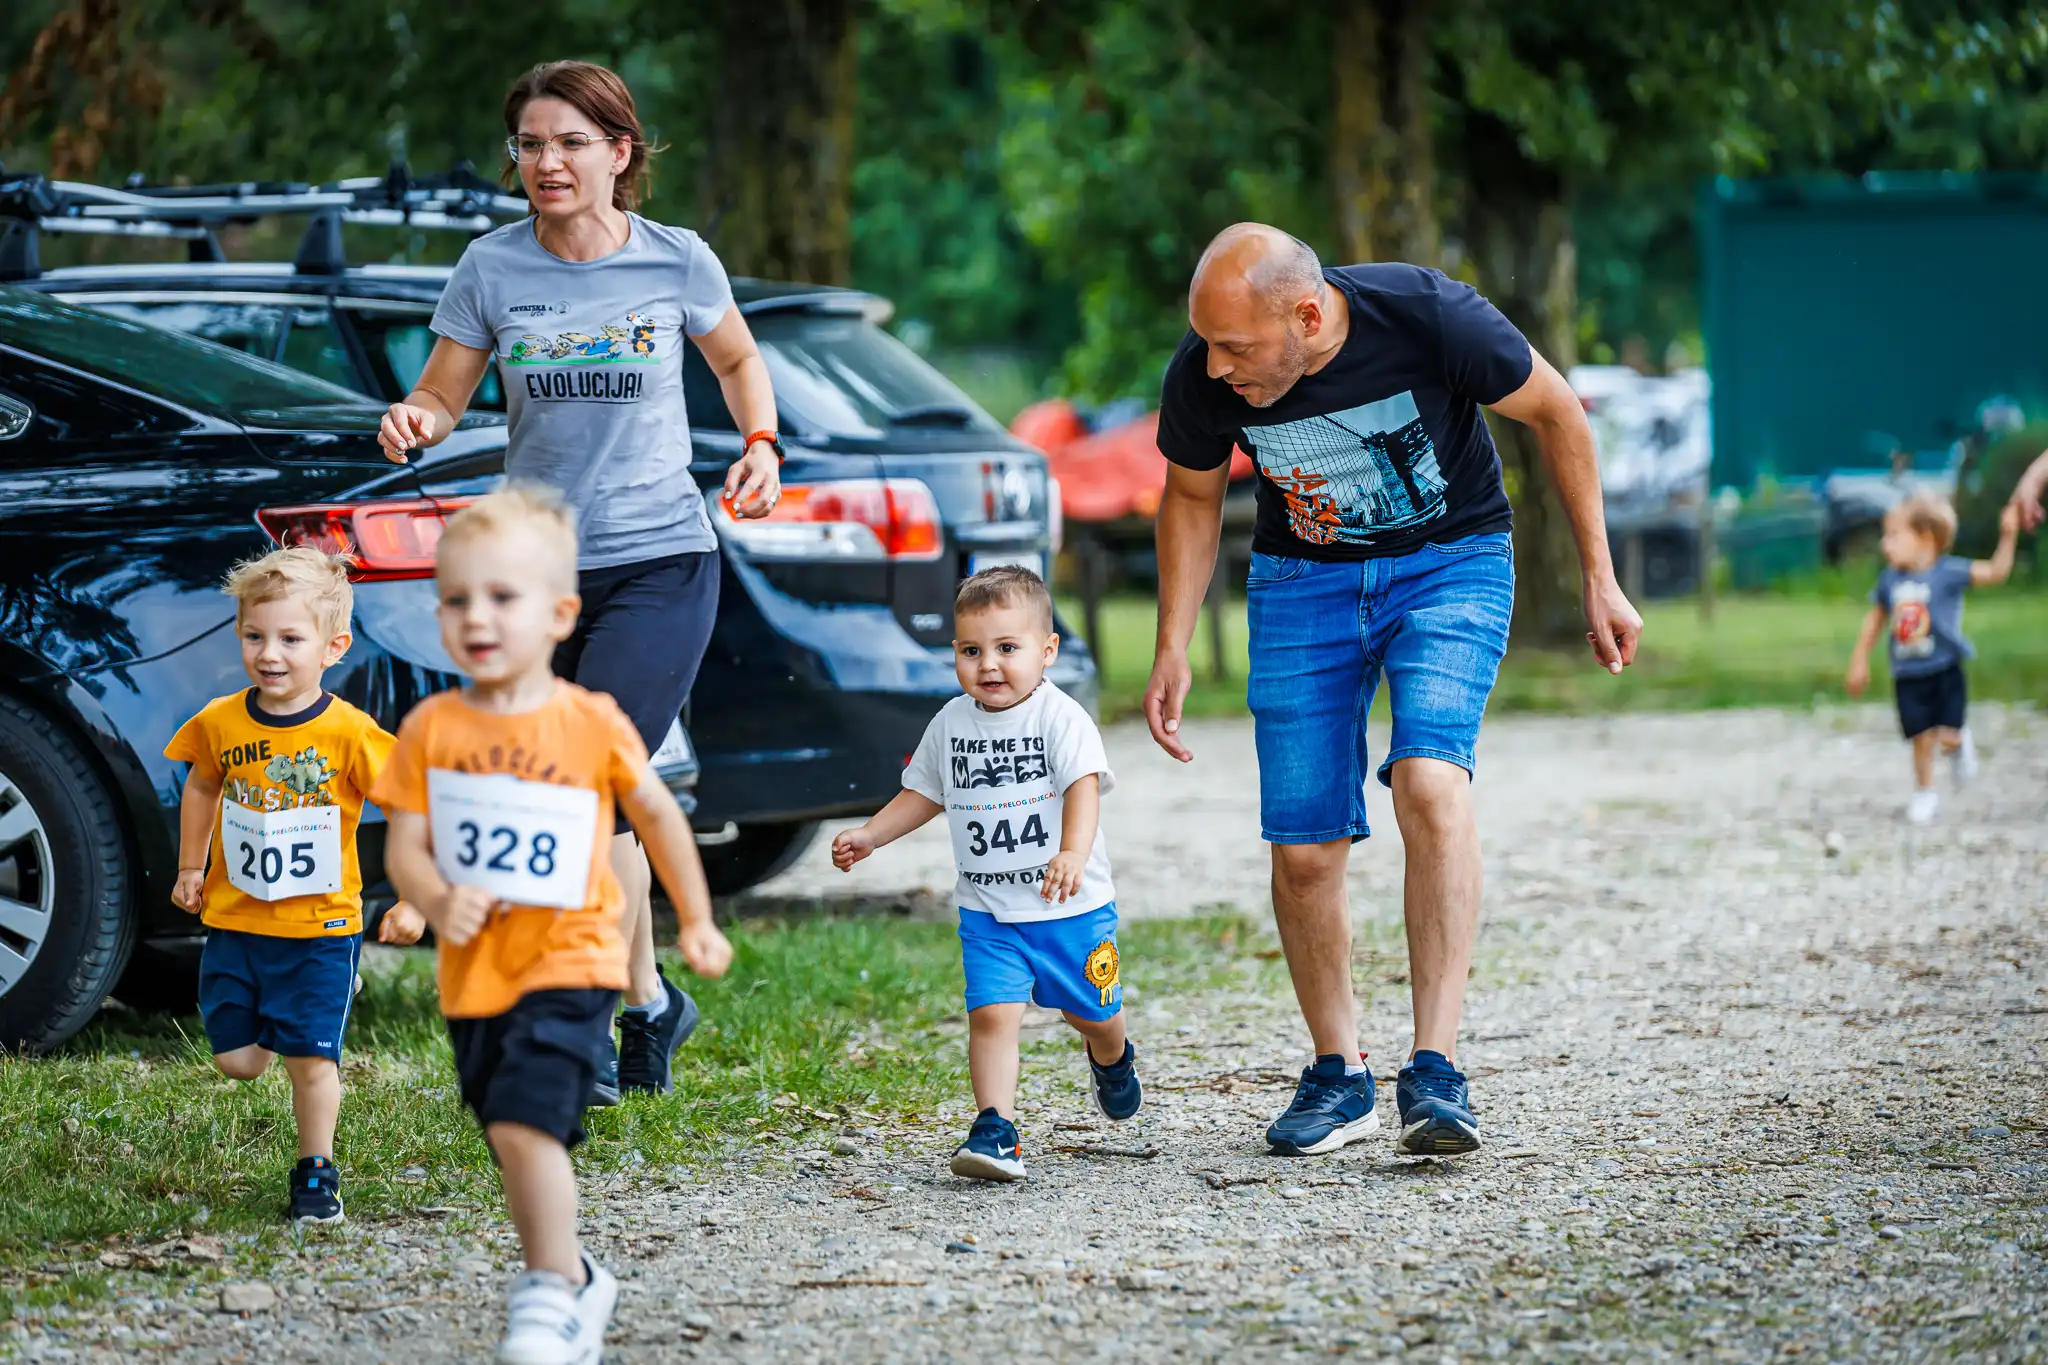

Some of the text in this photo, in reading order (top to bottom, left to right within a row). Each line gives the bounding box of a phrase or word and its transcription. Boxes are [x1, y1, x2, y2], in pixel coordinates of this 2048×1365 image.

[526, 372, 643, 398] EVOLUCIJA!
[951, 737, 1044, 754] TAKE ME TO
[998, 799, 1028, 809] PRELOG
[1028, 791, 1057, 804] (DJECA)
[271, 825, 299, 836] PRELOG
[300, 824, 332, 833] (DJECA)
[966, 813, 1049, 857] 344
[456, 820, 558, 877] 328
[239, 841, 316, 884] 205
